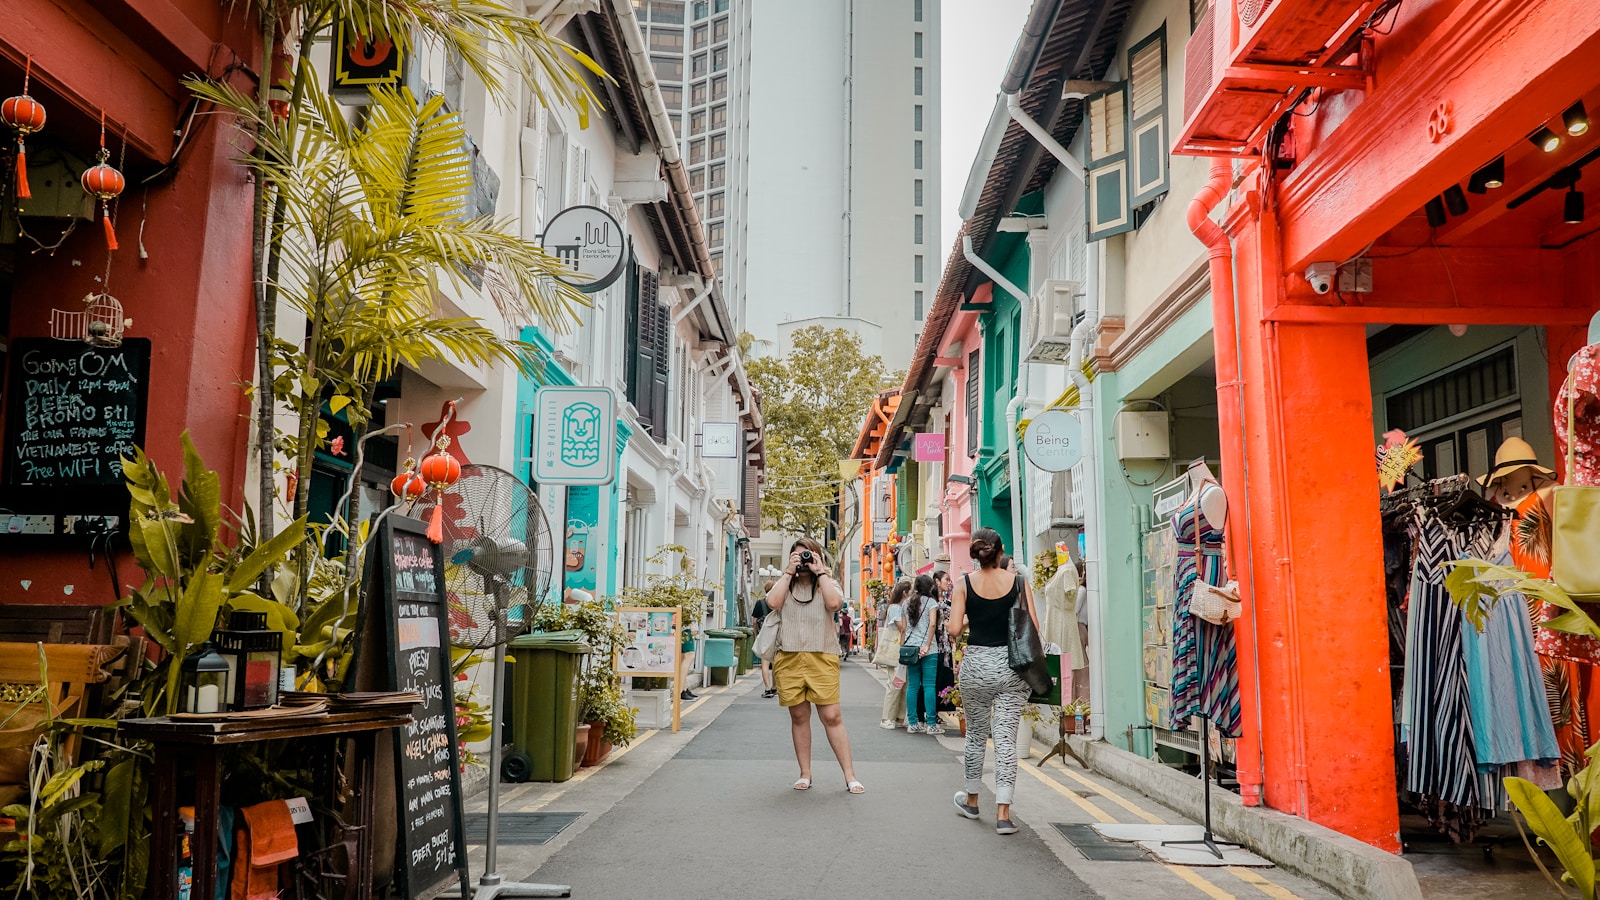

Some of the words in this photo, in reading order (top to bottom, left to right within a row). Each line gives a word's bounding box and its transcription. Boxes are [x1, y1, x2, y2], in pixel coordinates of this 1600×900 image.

[1427, 100, 1449, 143] 68
[1036, 435, 1069, 448] Being
[1037, 446, 1077, 457] Centre
[58, 458, 100, 477] WIFI
[412, 842, 432, 867] BEER
